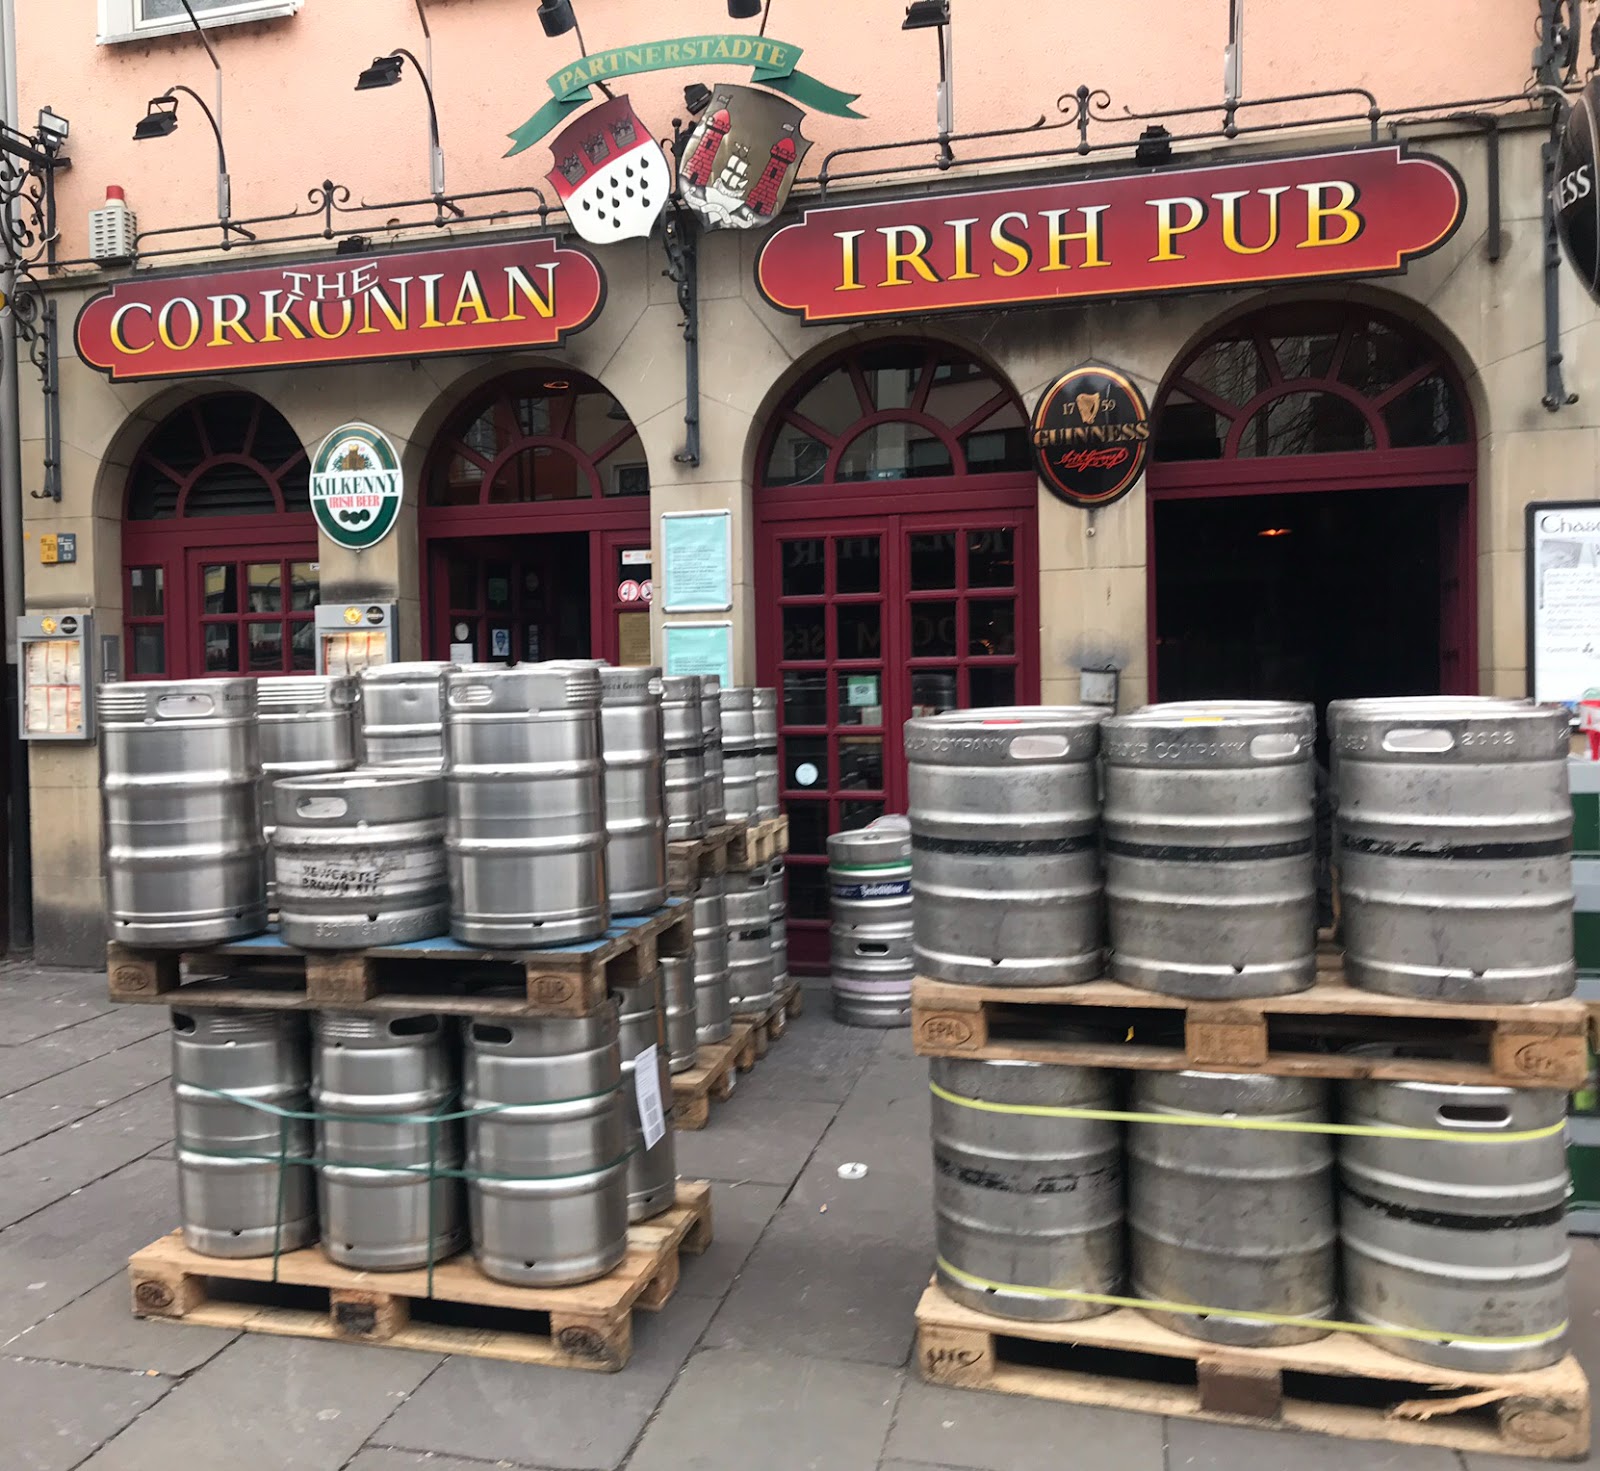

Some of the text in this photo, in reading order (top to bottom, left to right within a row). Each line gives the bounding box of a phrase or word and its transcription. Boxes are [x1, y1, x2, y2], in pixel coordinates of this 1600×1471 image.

[557, 36, 788, 94] PARTNERSTÄDTE
[833, 179, 1366, 292] IRISH PUB
[282, 261, 380, 300] THE
[1033, 422, 1151, 448] GUINNESS
[312, 473, 400, 496] KILKENNY
[329, 495, 380, 509] IRISH BEER
